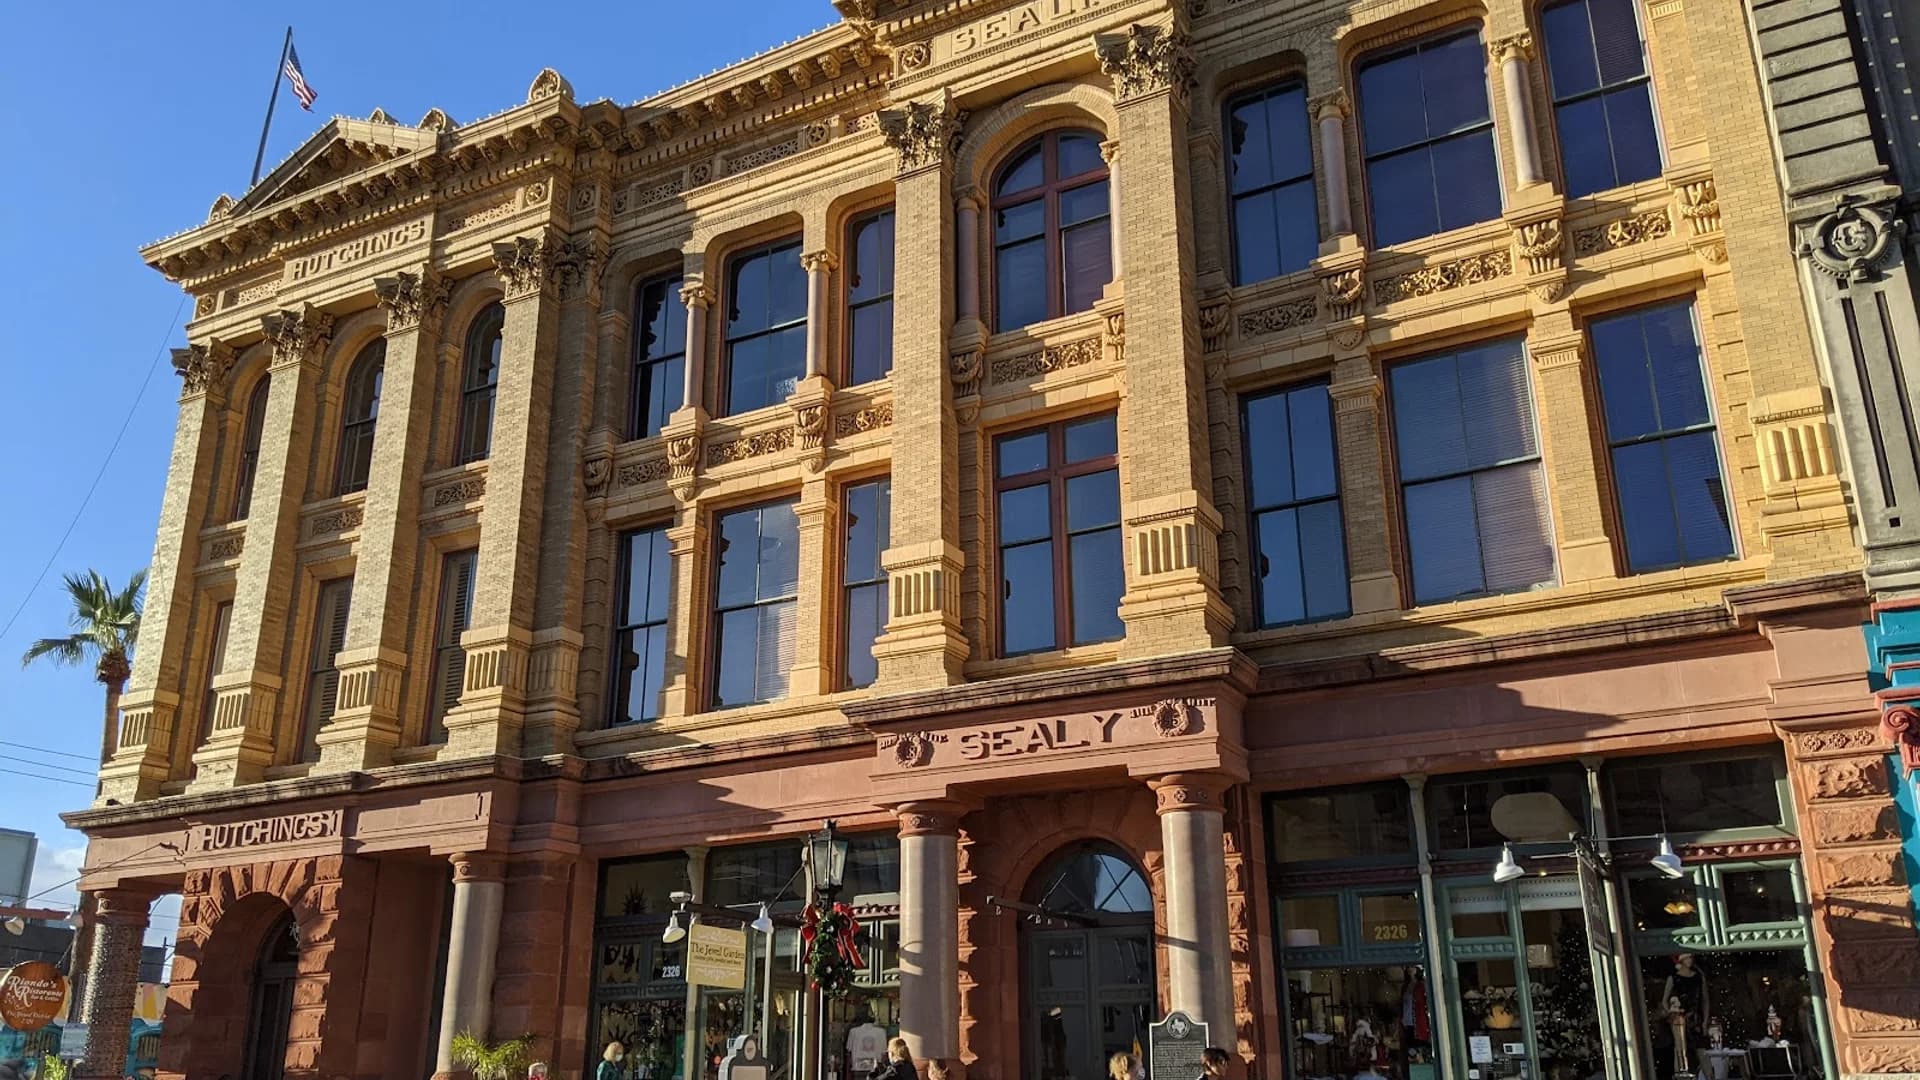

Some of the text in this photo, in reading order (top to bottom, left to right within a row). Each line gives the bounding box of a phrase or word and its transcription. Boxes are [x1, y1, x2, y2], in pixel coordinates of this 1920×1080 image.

[954, 0, 1099, 54] SEAL
[292, 220, 426, 280] HUTCHINGS
[960, 712, 1122, 760] SEALY
[202, 812, 329, 850] HUTCHINGS
[691, 942, 704, 954] The
[1374, 924, 1408, 940] 2326
